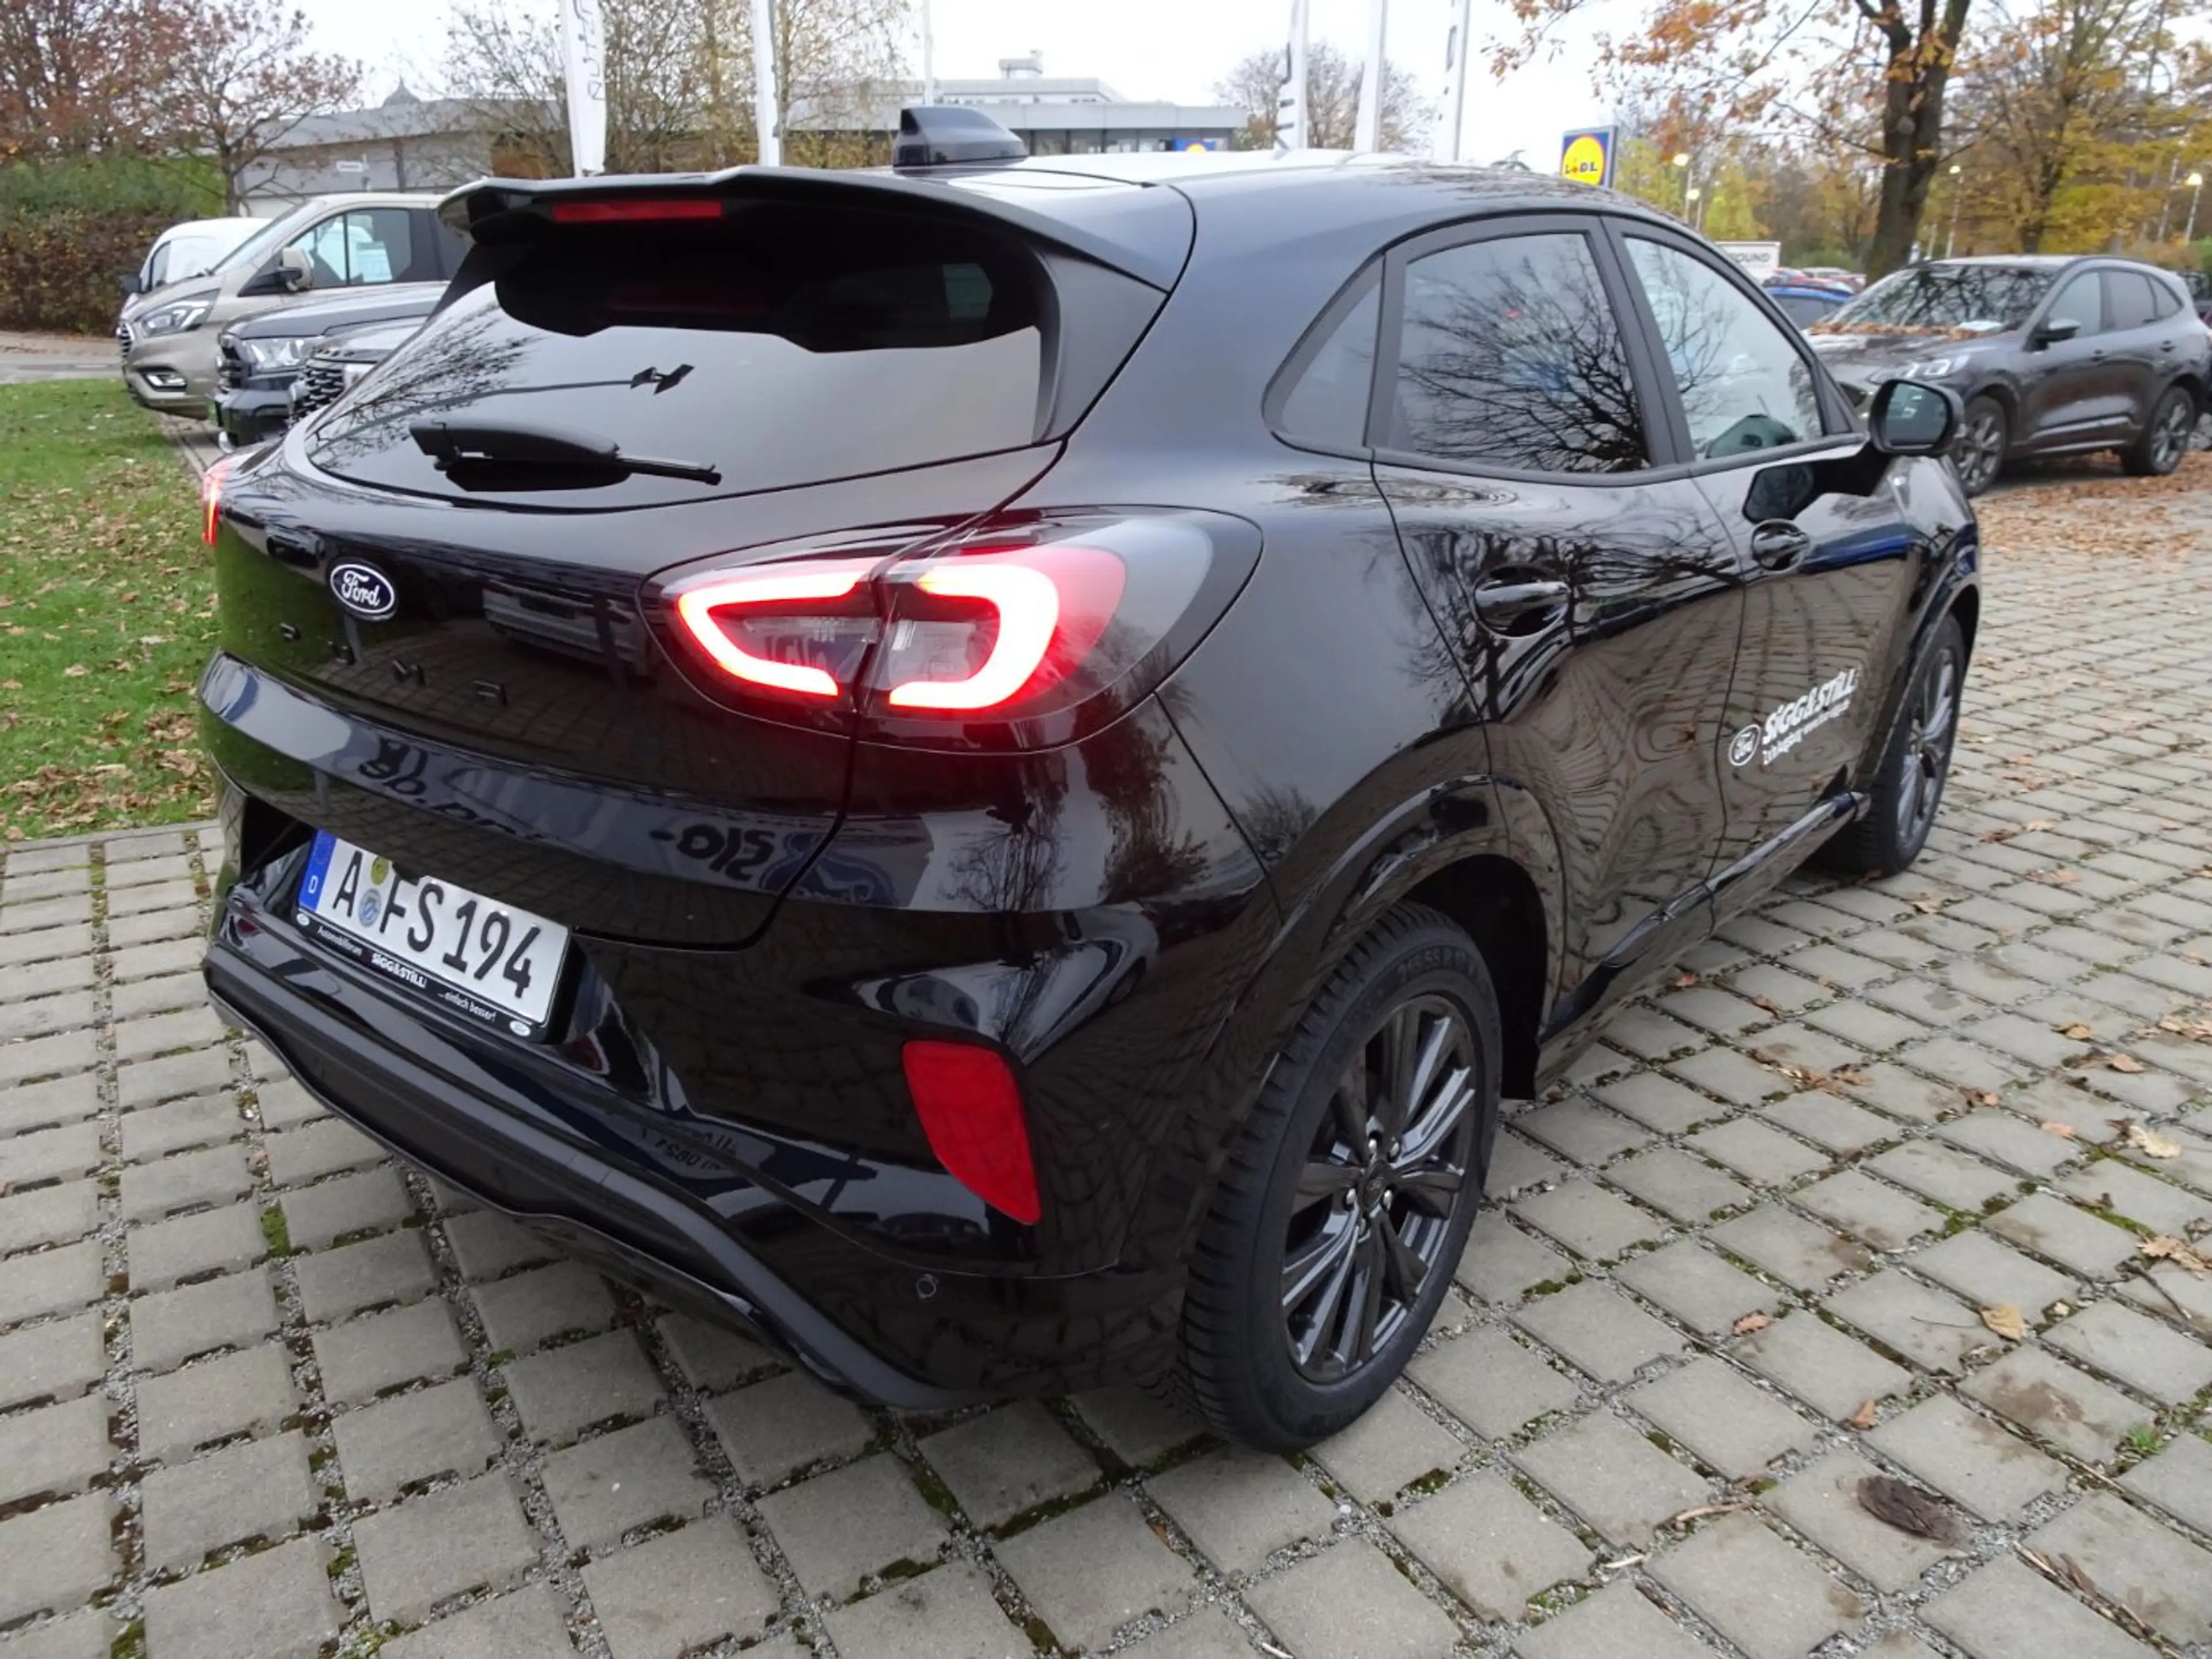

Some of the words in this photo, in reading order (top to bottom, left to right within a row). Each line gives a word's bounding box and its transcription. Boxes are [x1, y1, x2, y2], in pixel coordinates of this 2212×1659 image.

[342, 570, 380, 607] Ford
[309, 875, 318, 893] D
[332, 850, 362, 918] A
